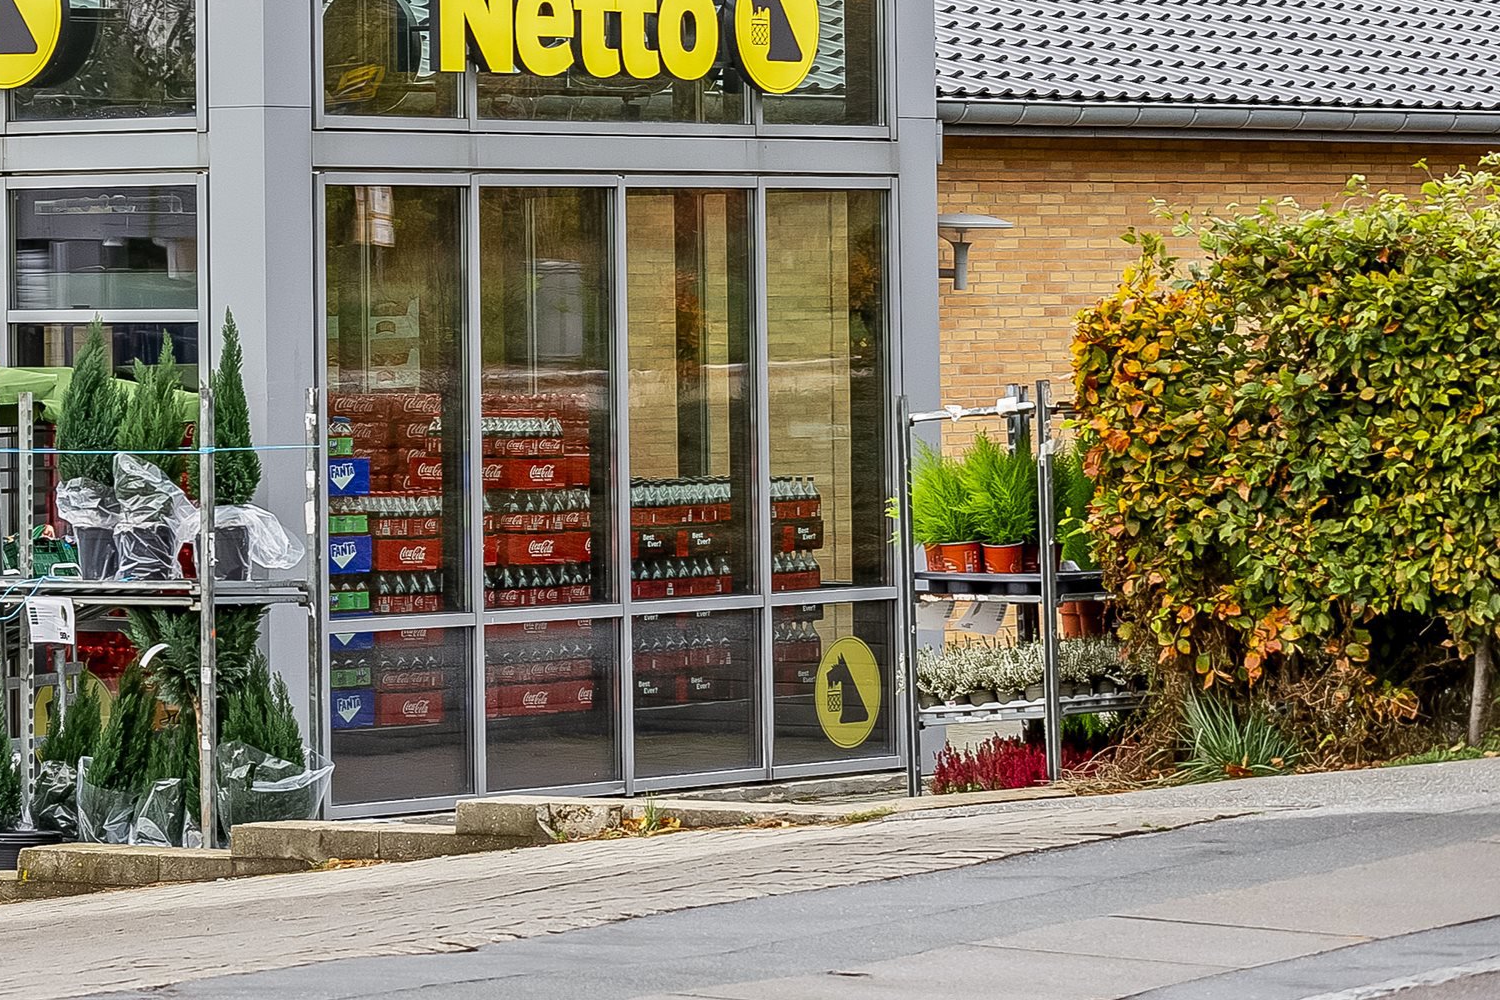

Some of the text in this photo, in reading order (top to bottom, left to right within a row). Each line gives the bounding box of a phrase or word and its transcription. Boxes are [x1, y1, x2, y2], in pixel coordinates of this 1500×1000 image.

[329, 462, 356, 479] FANTA
[529, 464, 555, 479] Coca-Cola
[330, 541, 357, 558] FANTA
[399, 546, 426, 561] Coca-Cola
[528, 539, 555, 554] Coca-Cola
[337, 696, 362, 712] FANTA
[523, 691, 549, 705] Coca-Cola
[402, 699, 430, 714] Coca-Cola
